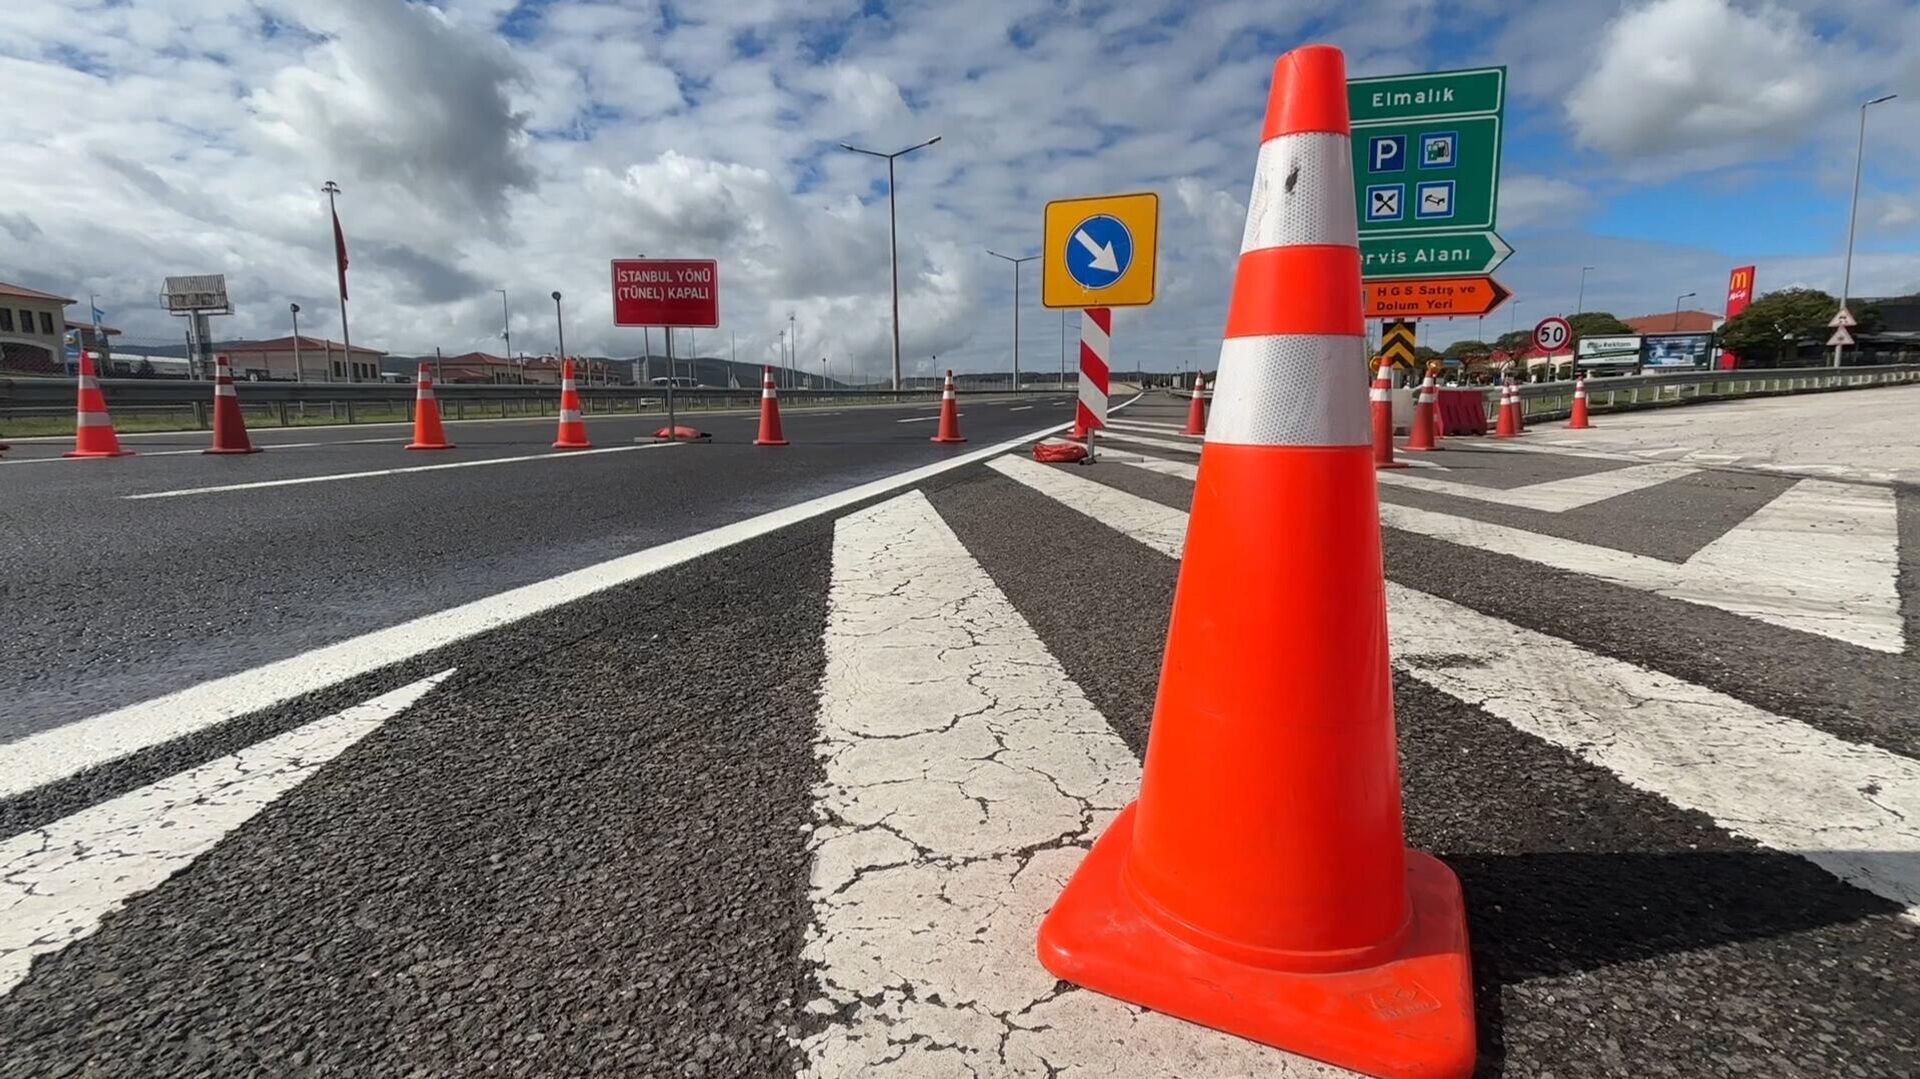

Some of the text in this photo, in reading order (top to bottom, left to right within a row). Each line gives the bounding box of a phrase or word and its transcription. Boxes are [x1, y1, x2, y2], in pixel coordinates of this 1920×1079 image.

[1372, 87, 1455, 107] Elmalık
[1376, 139, 1398, 170] P
[1360, 248, 1471, 265] rvis Alanı
[617, 267, 711, 282] İSTANBUL YÖNÜ
[618, 285, 709, 301] (TÜNEL) KAPALI
[1419, 285, 1454, 296] Satış
[1460, 285, 1476, 294] ve
[1376, 299, 1453, 311] Dolum Yeri
[1540, 326, 1564, 343] 50
